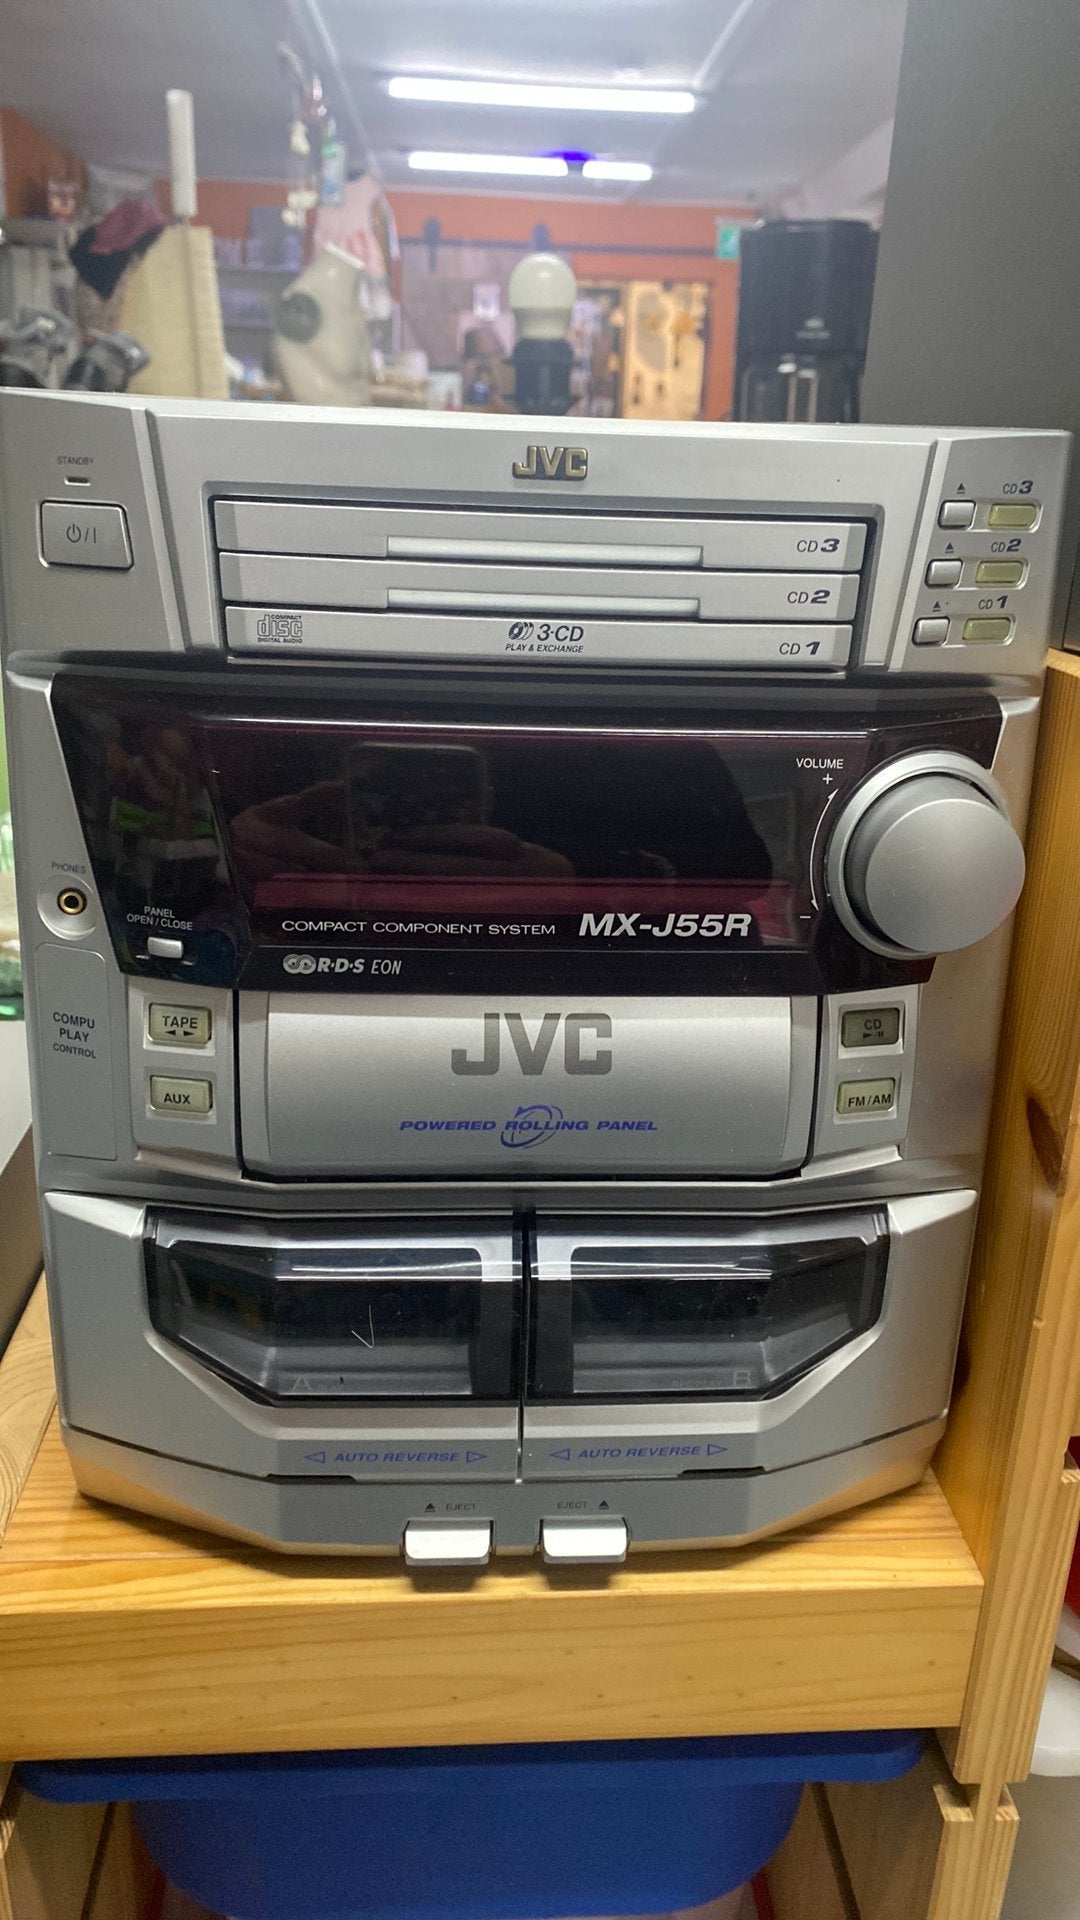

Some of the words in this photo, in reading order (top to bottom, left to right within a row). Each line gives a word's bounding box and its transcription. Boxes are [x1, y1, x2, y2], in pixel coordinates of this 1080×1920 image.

[57, 456, 95, 466] STANDBY
[512, 446, 589, 481] JVC
[257, 614, 303, 637] disc
[505, 643, 528, 651] PLAY
[528, 644, 534, 652] &
[536, 644, 584, 653] EXCHANGE
[796, 758, 844, 769] VOLUME
[51, 861, 86, 874] PHONES
[144, 905, 176, 918] PANEL
[281, 920, 367, 932] COMPACT
[372, 922, 483, 935] COMPONENT
[488, 923, 556, 936] SYSTEM
[578, 912, 752, 938] MX-J55R
[370, 959, 402, 975] EON
[52, 1011, 96, 1029] COMPU
[162, 1015, 198, 1030] TAPE
[864, 1018, 882, 1031] CD
[59, 1028, 90, 1043] PLAY
[450, 1012, 613, 1076] JVC
[52, 1043, 97, 1059] CONTROL
[163, 1092, 191, 1105] AUX
[847, 1093, 892, 1108] FM/AM
[400, 1120, 497, 1131] POWERED
[504, 1120, 589, 1131] ROLLING
[596, 1120, 658, 1131] PANEL
[334, 1452, 379, 1462] AUTO
[383, 1452, 461, 1462] REVERSE
[578, 1449, 622, 1459] AUTO
[625, 1446, 701, 1458] REVERSE
[445, 1503, 477, 1511] EJECT
[557, 1501, 588, 1509] EJECT
